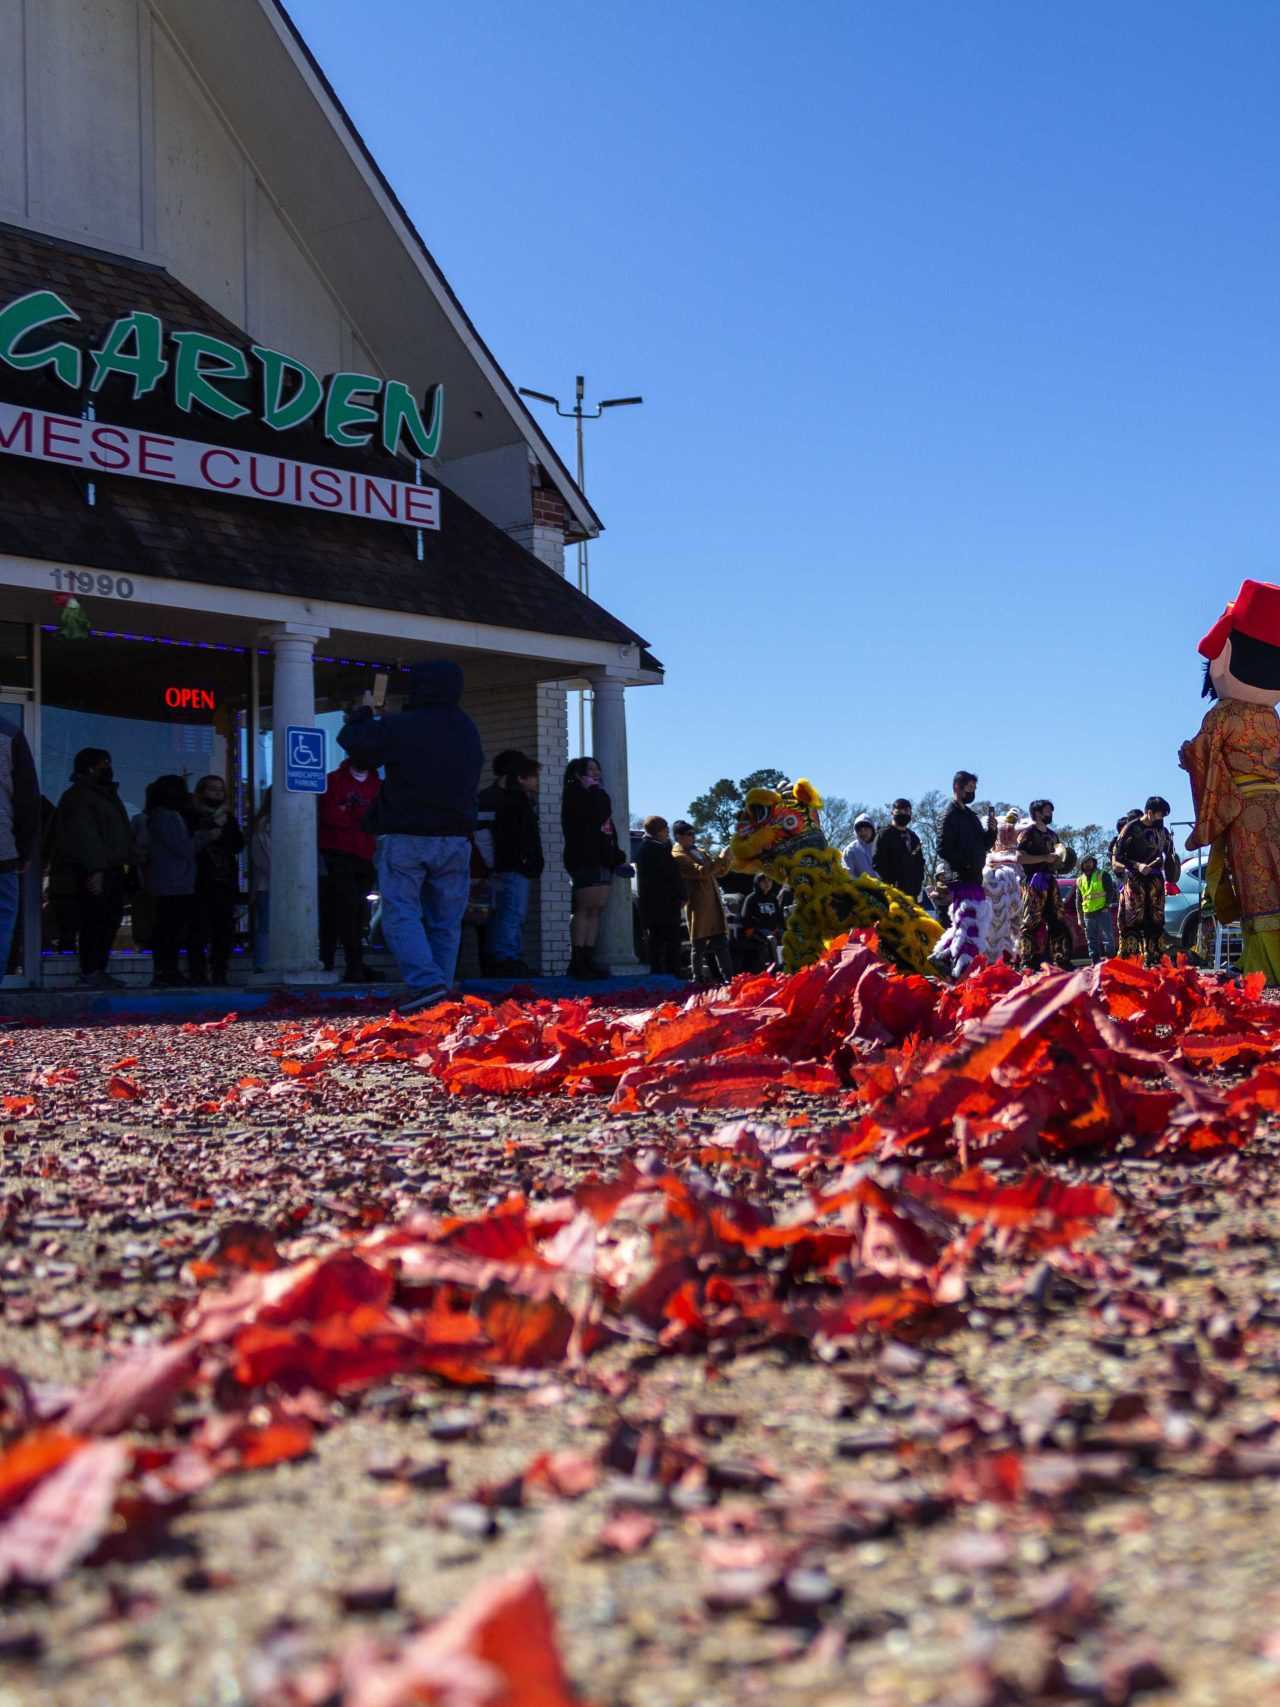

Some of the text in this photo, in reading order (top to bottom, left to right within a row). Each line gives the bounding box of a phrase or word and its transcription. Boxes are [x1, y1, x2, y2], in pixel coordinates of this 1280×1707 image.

[0, 290, 444, 459] GARDEN
[199, 449, 436, 526] CUISINE
[49, 568, 134, 598] 11990
[164, 687, 217, 710] OPEN
